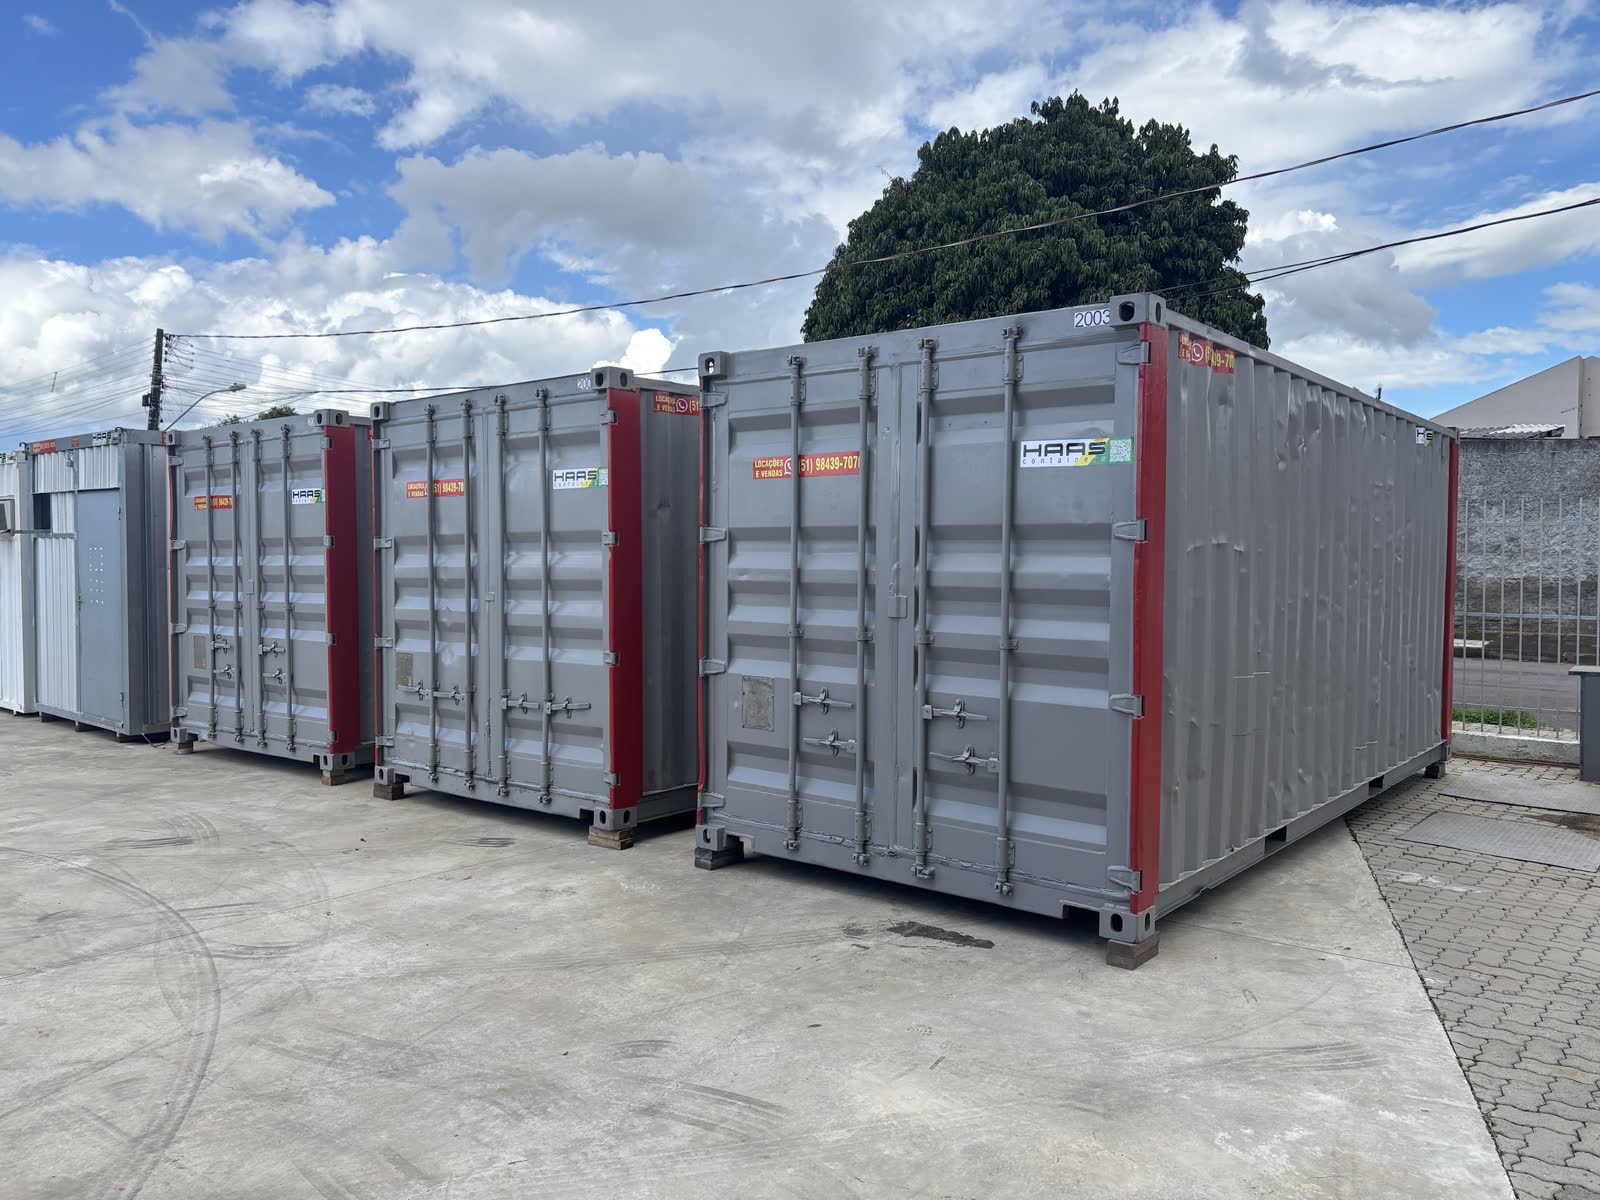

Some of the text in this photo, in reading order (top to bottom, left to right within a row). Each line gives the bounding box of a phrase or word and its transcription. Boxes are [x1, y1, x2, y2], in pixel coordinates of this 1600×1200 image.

[1075, 310, 1110, 328] 2003
[1023, 441, 1106, 457] HAAS
[754, 458, 783, 469] LOCAÇÕES
[554, 470, 597, 482] HAAS
[756, 470, 783, 478] E VENDAS
[292, 490, 320, 499] HAAS
